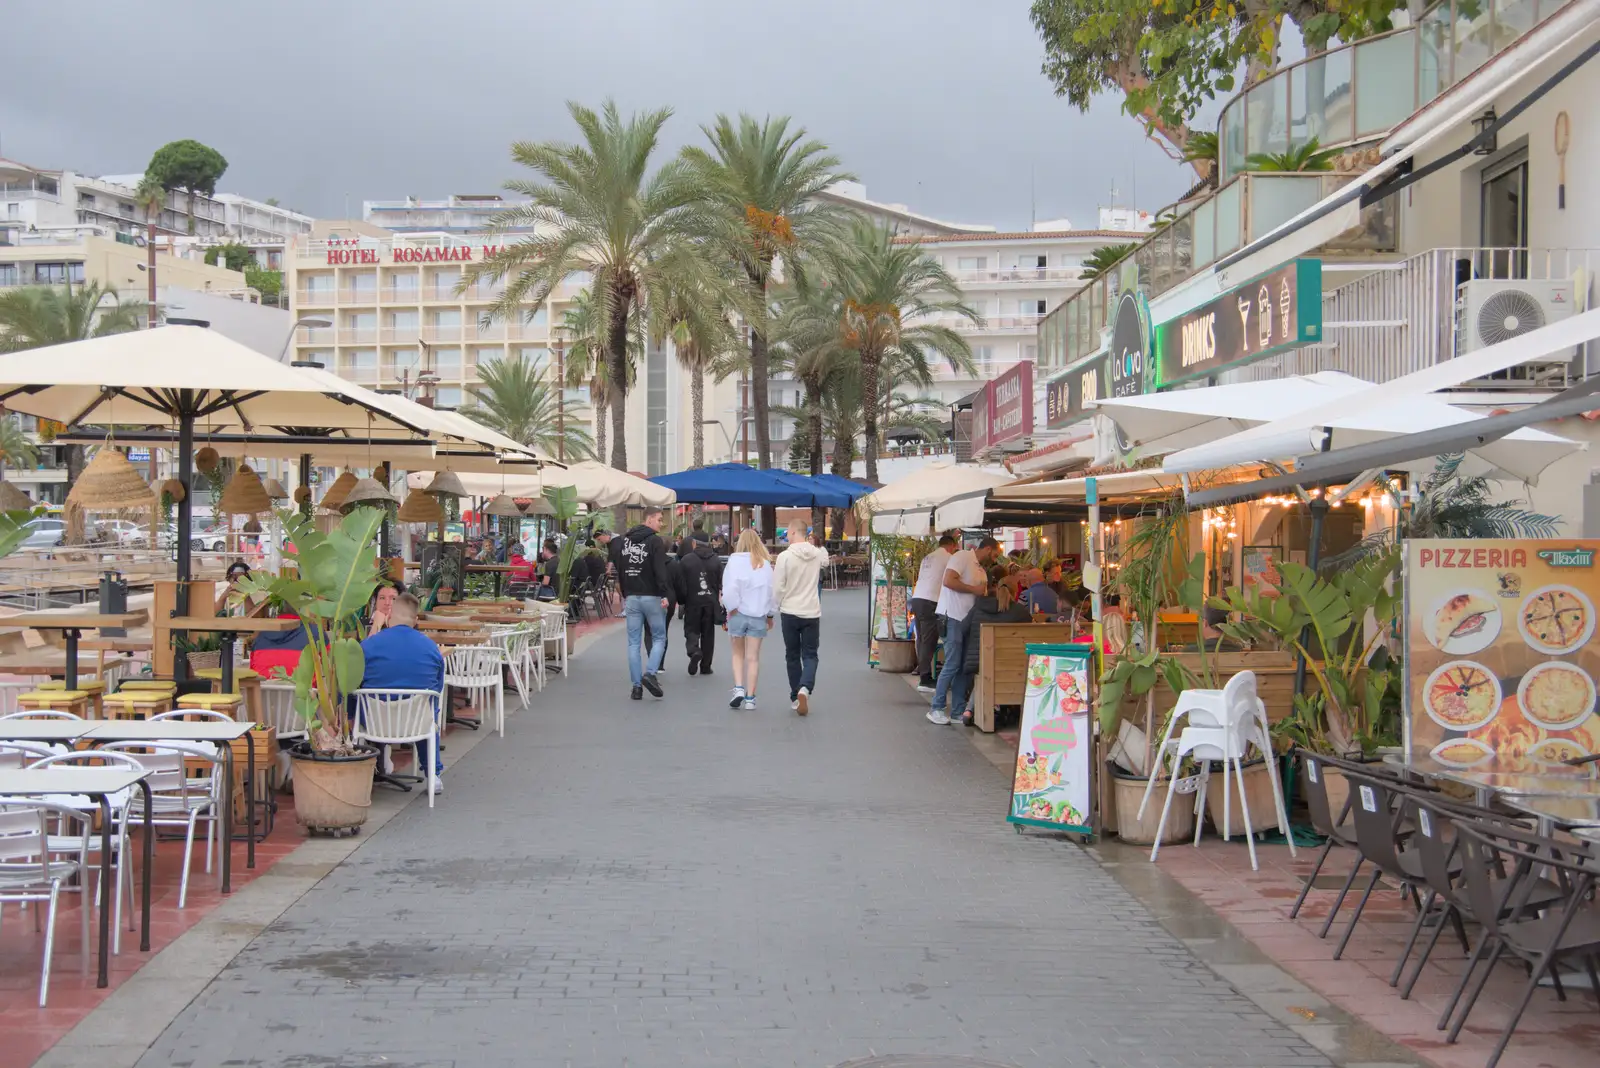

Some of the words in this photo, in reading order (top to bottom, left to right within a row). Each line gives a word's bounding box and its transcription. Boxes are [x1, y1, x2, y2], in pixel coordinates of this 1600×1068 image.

[327, 249, 380, 265] HOTEL
[393, 245, 473, 263] ROSAMAR
[1182, 312, 1215, 367] DRINKS
[1113, 353, 1121, 382] La
[1122, 346, 1141, 378] Cova
[1420, 548, 1527, 568] PIZZERIA
